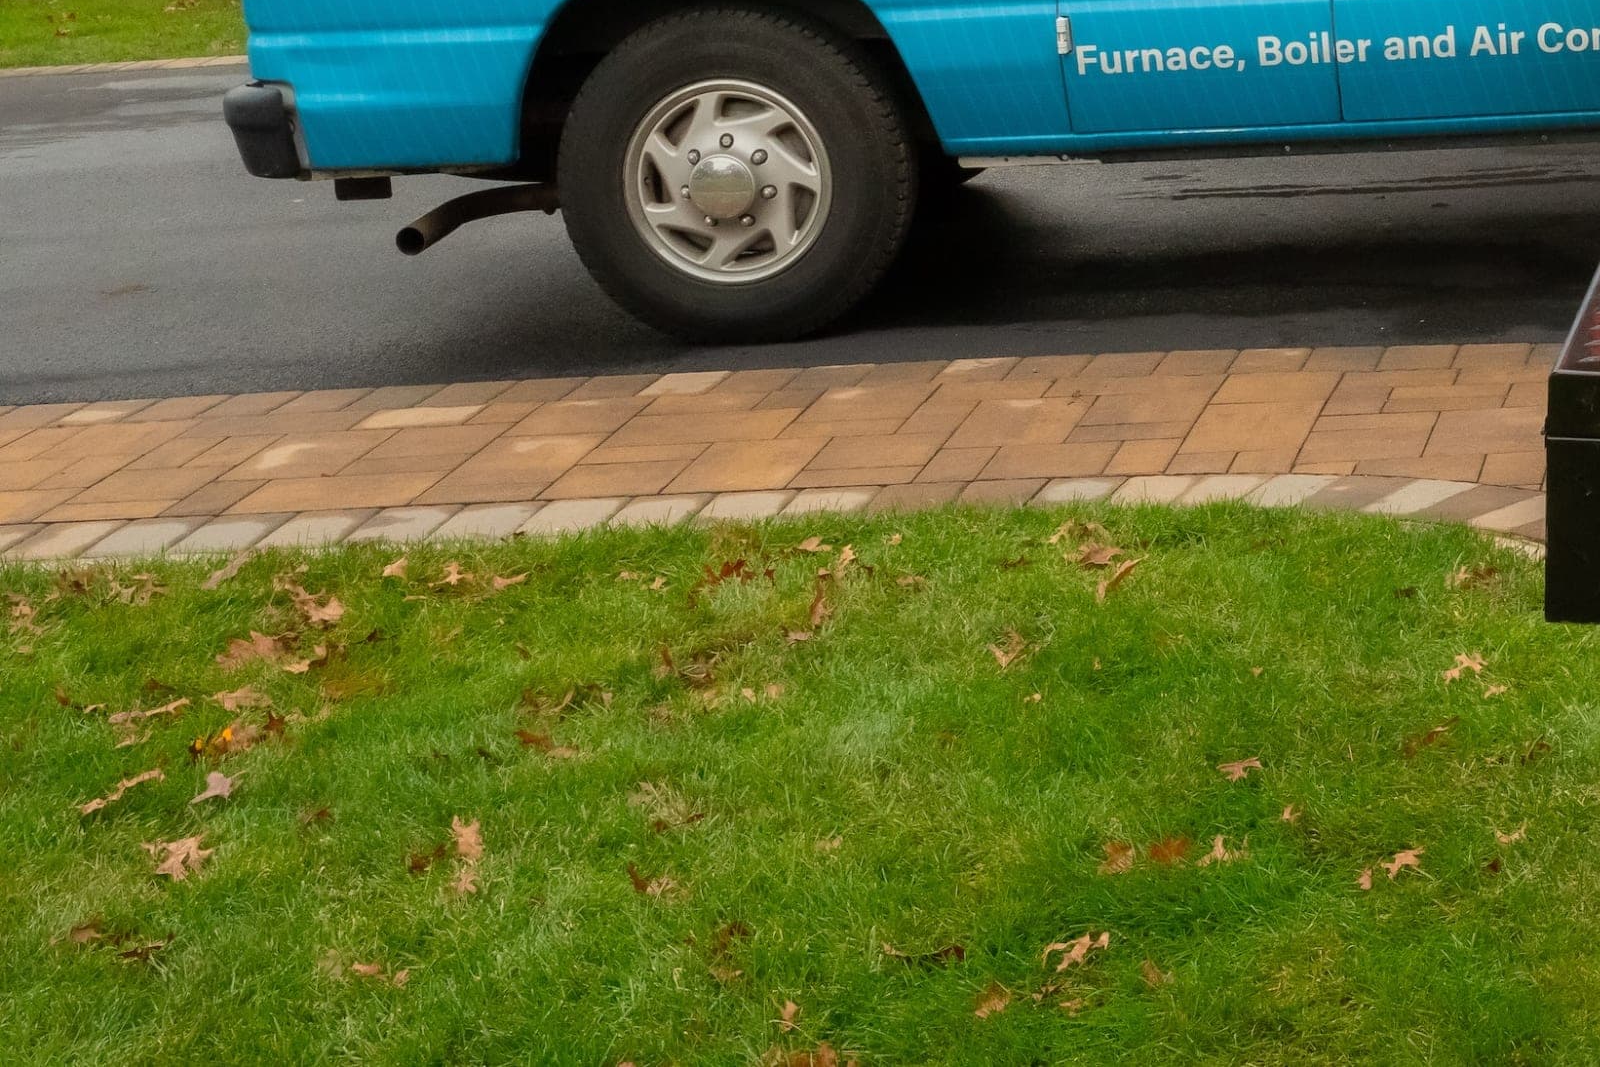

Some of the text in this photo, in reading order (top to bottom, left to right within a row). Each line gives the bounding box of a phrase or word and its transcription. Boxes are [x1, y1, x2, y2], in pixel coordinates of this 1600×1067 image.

[1075, 43, 1246, 77] Furnace,
[1257, 33, 1370, 68] Boiler
[1382, 25, 1457, 62] and
[1469, 19, 1525, 58] Air
